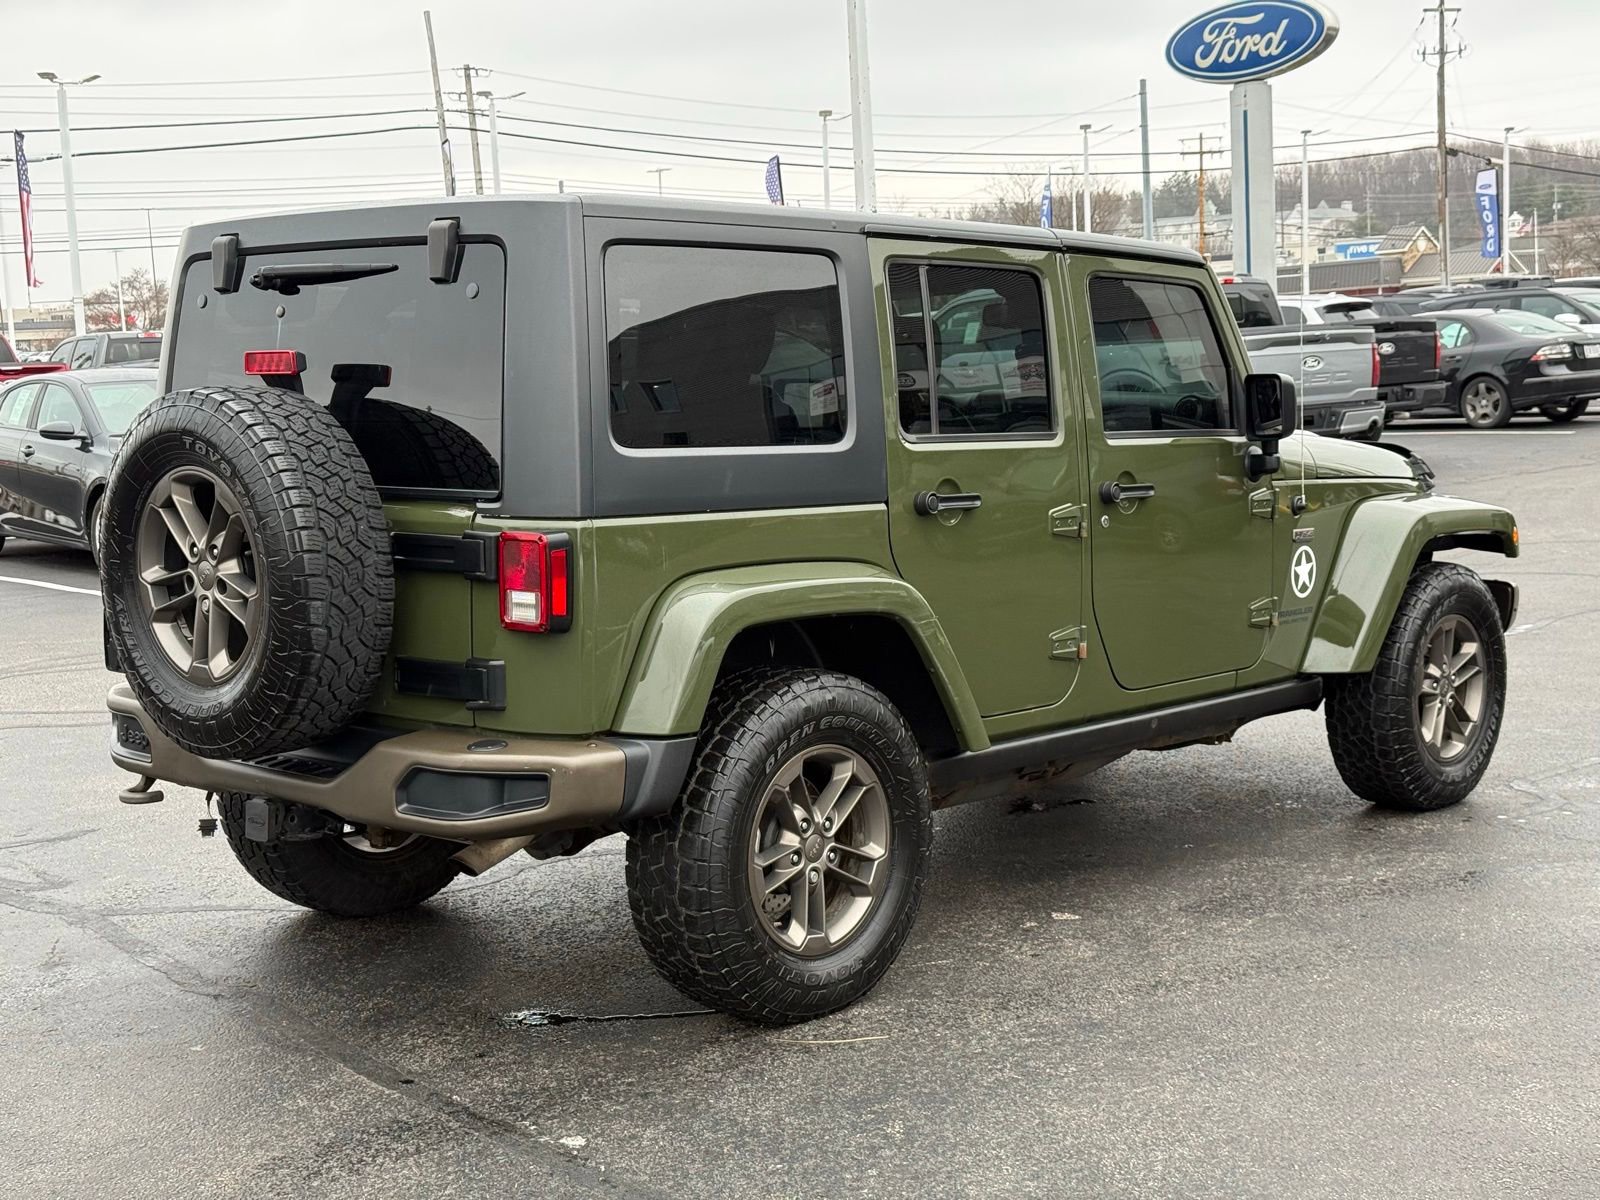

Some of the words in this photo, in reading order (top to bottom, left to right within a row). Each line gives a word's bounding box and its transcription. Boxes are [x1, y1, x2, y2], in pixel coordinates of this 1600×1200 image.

[1195, 12, 1289, 68] Ford
[181, 435, 232, 478] TOYO
[113, 593, 175, 705] COUNTRY
[174, 702, 224, 719] OPEN
[765, 720, 817, 775] OPEN
[819, 715, 901, 761] COUNTRY
